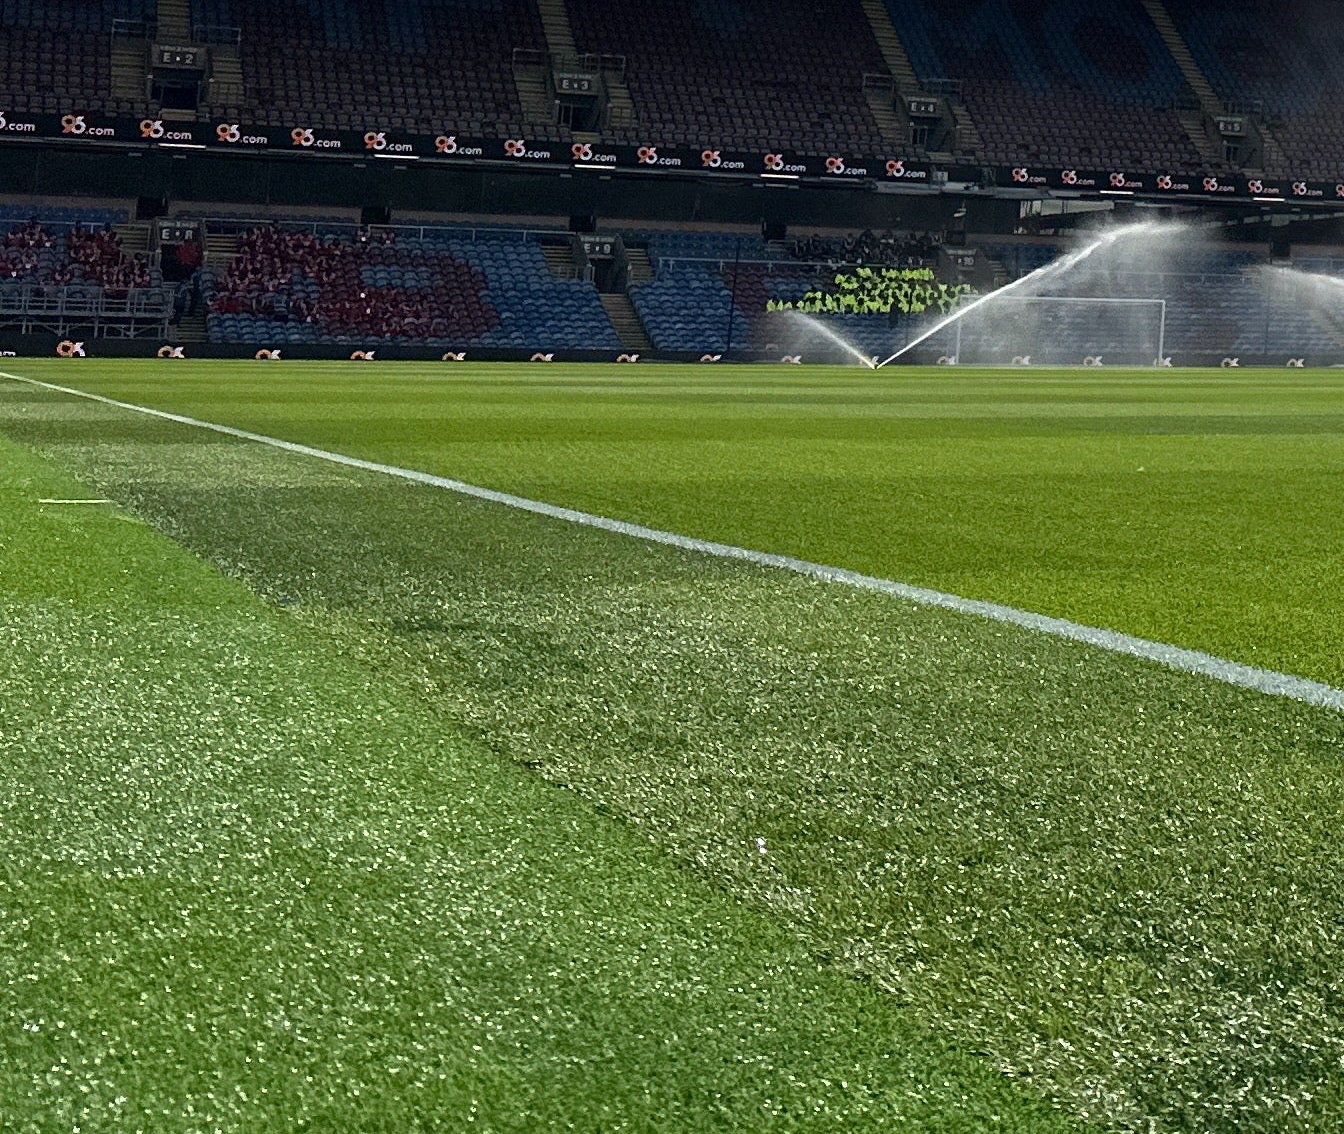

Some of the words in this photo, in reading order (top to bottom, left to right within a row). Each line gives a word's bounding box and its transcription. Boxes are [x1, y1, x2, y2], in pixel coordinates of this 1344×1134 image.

[61, 114, 115, 136] 96.com
[140, 119, 192, 140] 96.com
[216, 123, 268, 144] 96.com
[291, 127, 341, 148] 96.com
[364, 131, 413, 152] 96.com
[435, 135, 482, 155] 96.com
[504, 139, 550, 159] 96.com
[571, 143, 617, 163] 96.com
[637, 146, 681, 166] 96.com
[701, 150, 745, 169] 96.com
[764, 153, 806, 172] 96.com
[825, 156, 867, 176] 96.com
[886, 159, 926, 179] 96.com
